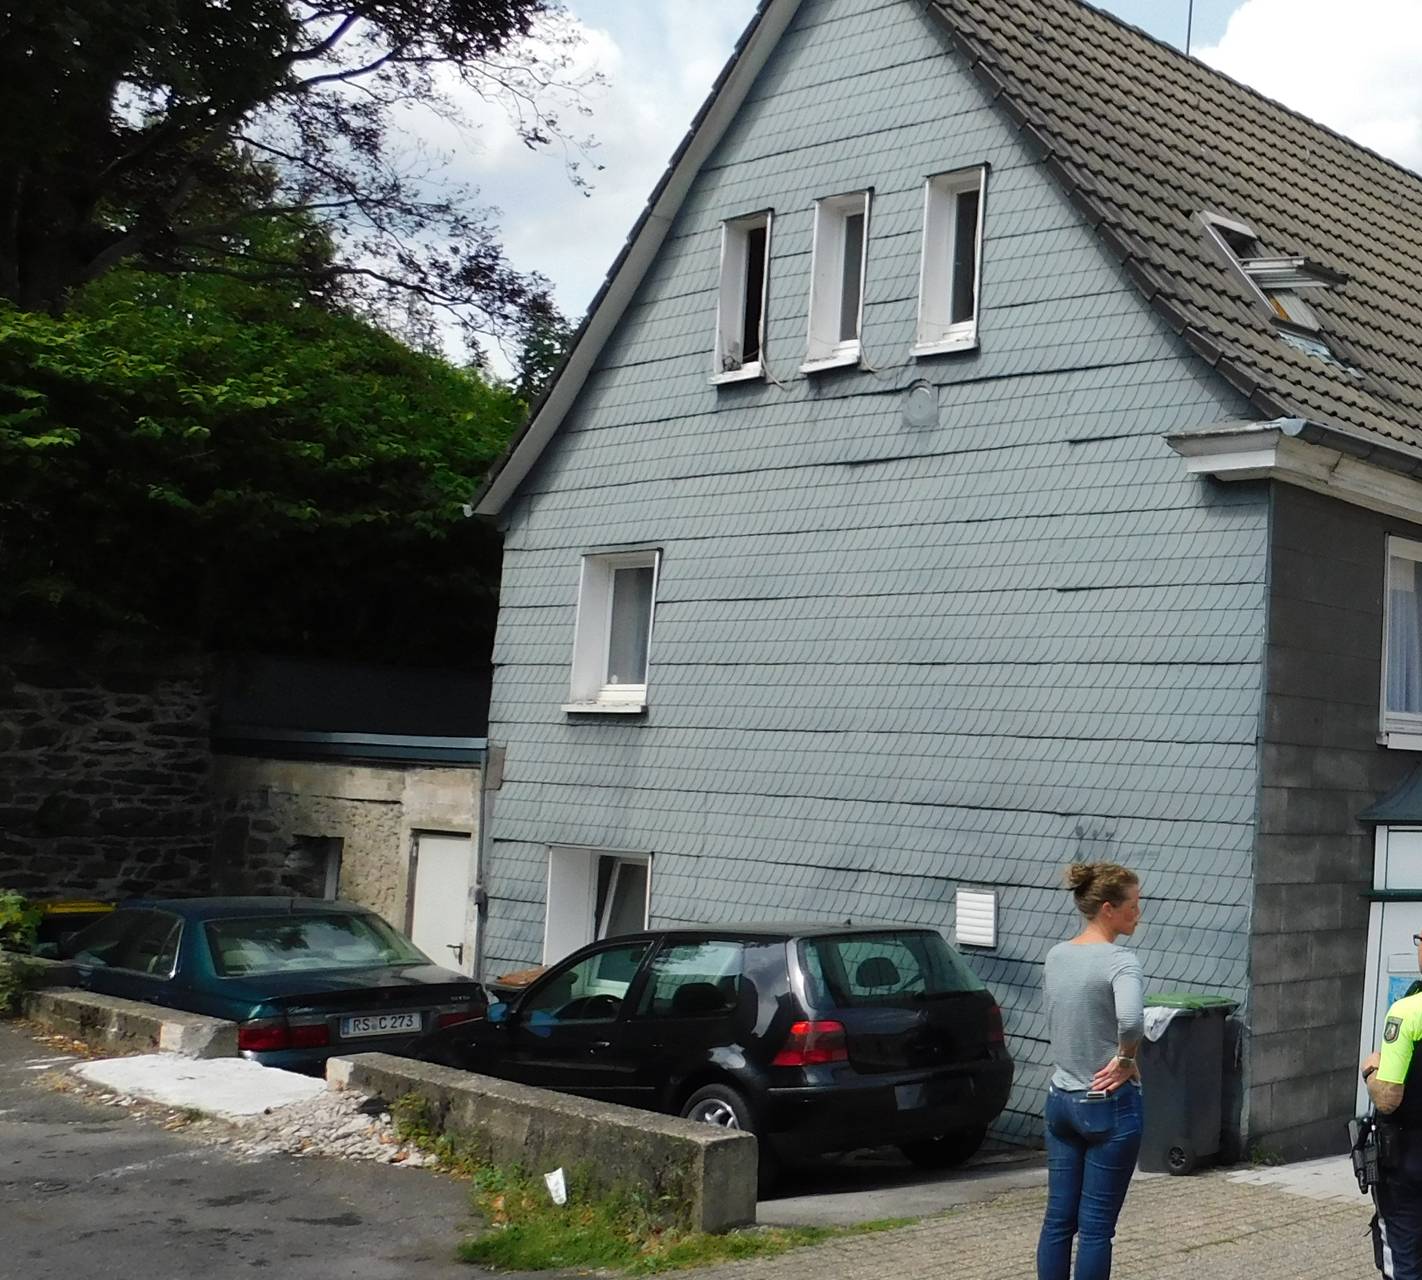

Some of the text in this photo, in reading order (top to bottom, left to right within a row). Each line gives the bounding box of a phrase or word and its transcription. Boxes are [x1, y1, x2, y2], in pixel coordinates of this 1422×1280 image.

[353, 1015, 413, 1032] RS C 273
